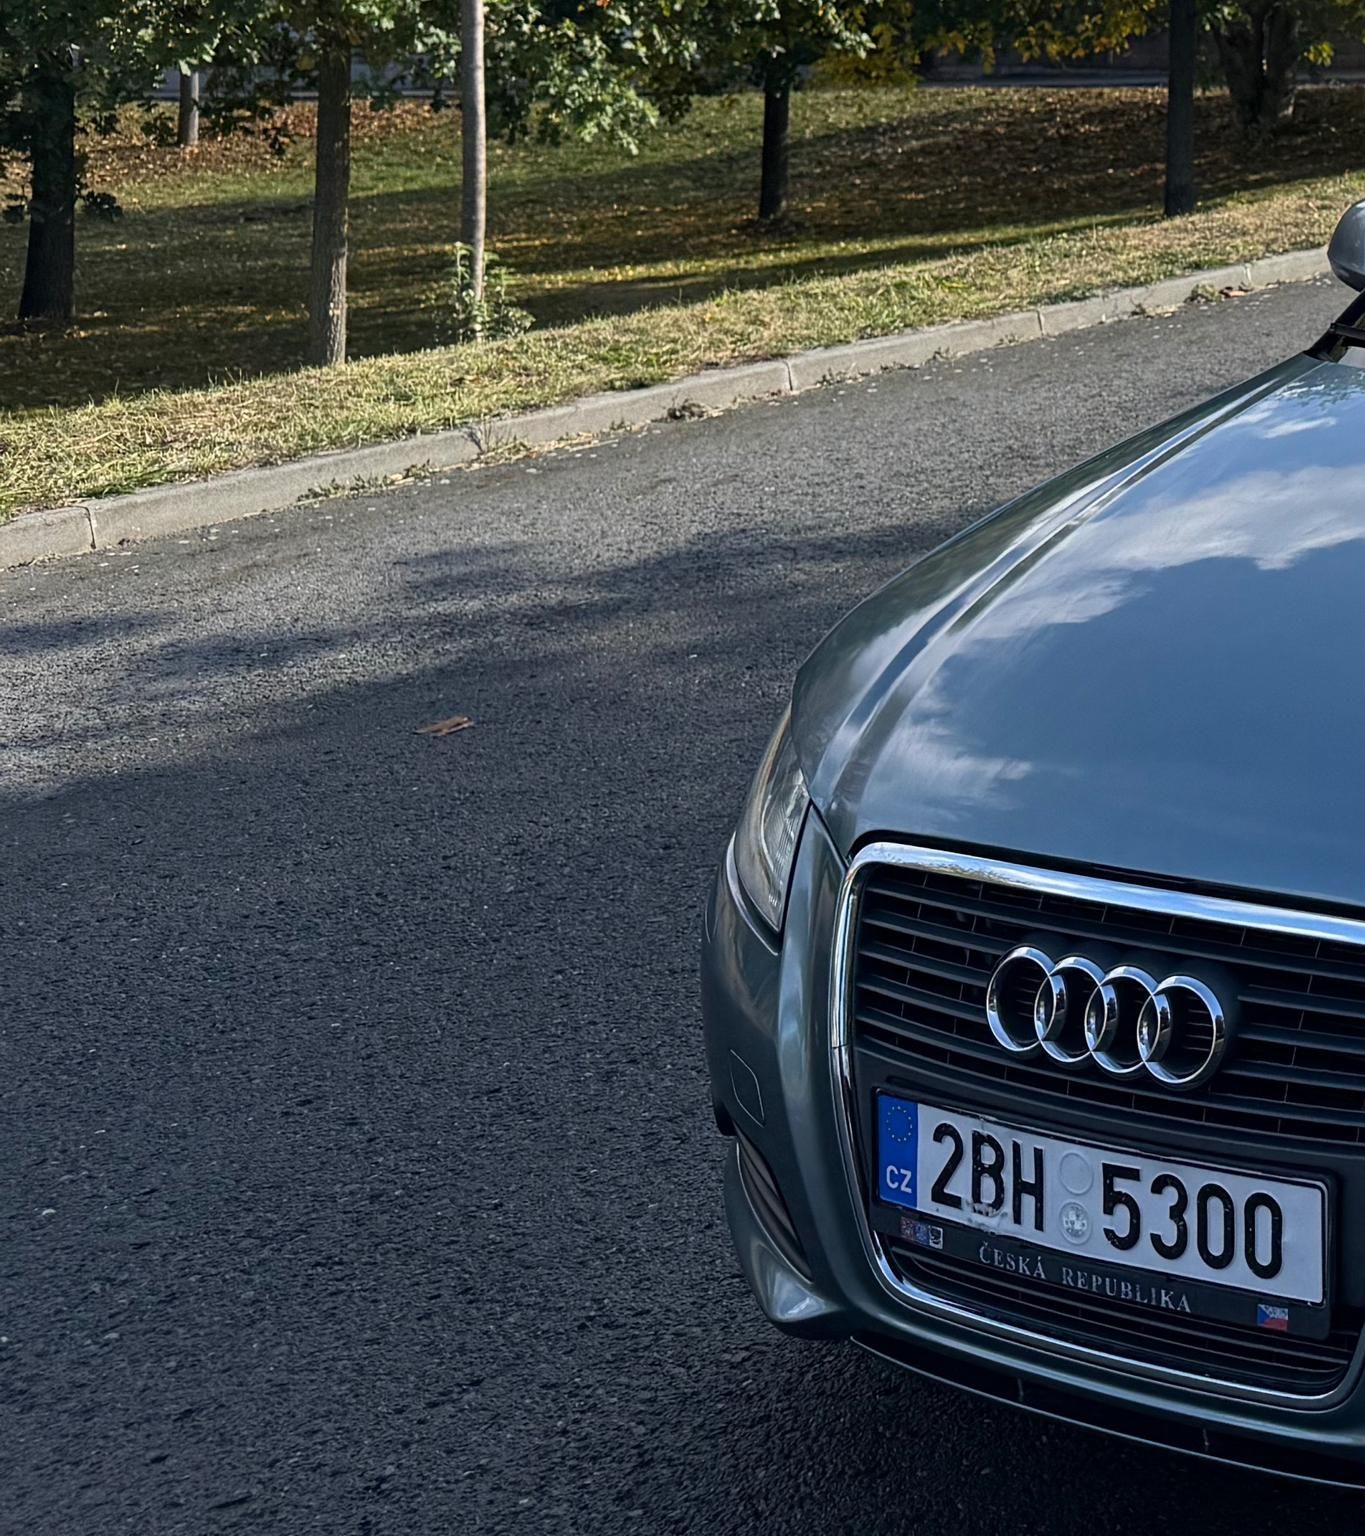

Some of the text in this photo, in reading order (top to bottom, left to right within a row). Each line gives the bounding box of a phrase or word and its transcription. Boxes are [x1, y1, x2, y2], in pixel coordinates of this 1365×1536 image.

[886, 1165, 912, 1194] CZ
[931, 1122, 1283, 1280] 2BH 5300
[979, 1241, 1192, 1313] ČESKÁ REPUBLIKA
